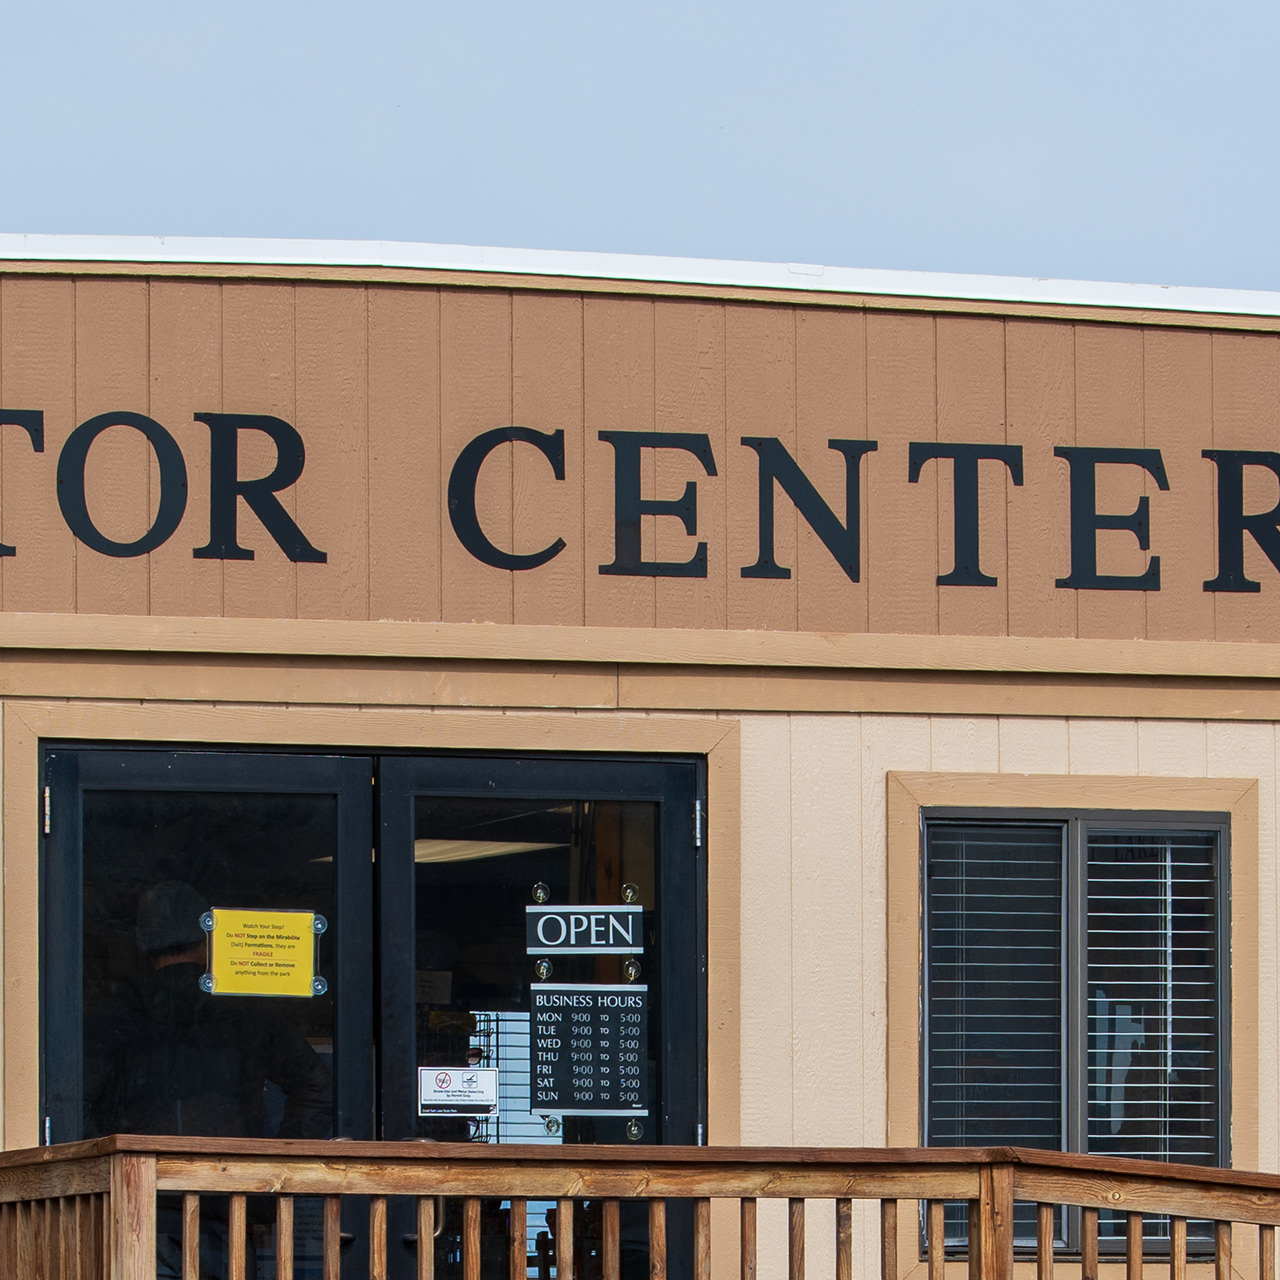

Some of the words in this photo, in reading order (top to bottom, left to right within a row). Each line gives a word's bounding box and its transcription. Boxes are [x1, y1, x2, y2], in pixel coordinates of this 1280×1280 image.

[537, 914, 633, 945] OPEN
[536, 995, 593, 1007] BUSINESS
[598, 996, 642, 1007] HOURS
[537, 1013, 562, 1021] MON
[571, 1013, 590, 1022] 9:00
[620, 1014, 640, 1022] 5:00
[537, 1026, 556, 1034] TUE
[572, 1026, 592, 1035] 9:00
[620, 1027, 640, 1036] 5:00
[537, 1039, 561, 1048] WED
[571, 1040, 592, 1048] 9:00
[620, 1040, 639, 1049] 5:00
[537, 1052, 558, 1061] THU
[571, 1052, 592, 1061] 9:00
[619, 1053, 638, 1062] 5:00
[537, 1065, 552, 1074] FRI
[573, 1066, 593, 1074] 9:00
[619, 1066, 639, 1075] 5:00
[537, 1078, 554, 1087] SAT
[572, 1078, 593, 1088] 9:00
[620, 1079, 640, 1088] 5:00
[537, 1092, 558, 1100] SUN
[574, 1092, 593, 1101] 9:00
[620, 1092, 638, 1101] 5:00
